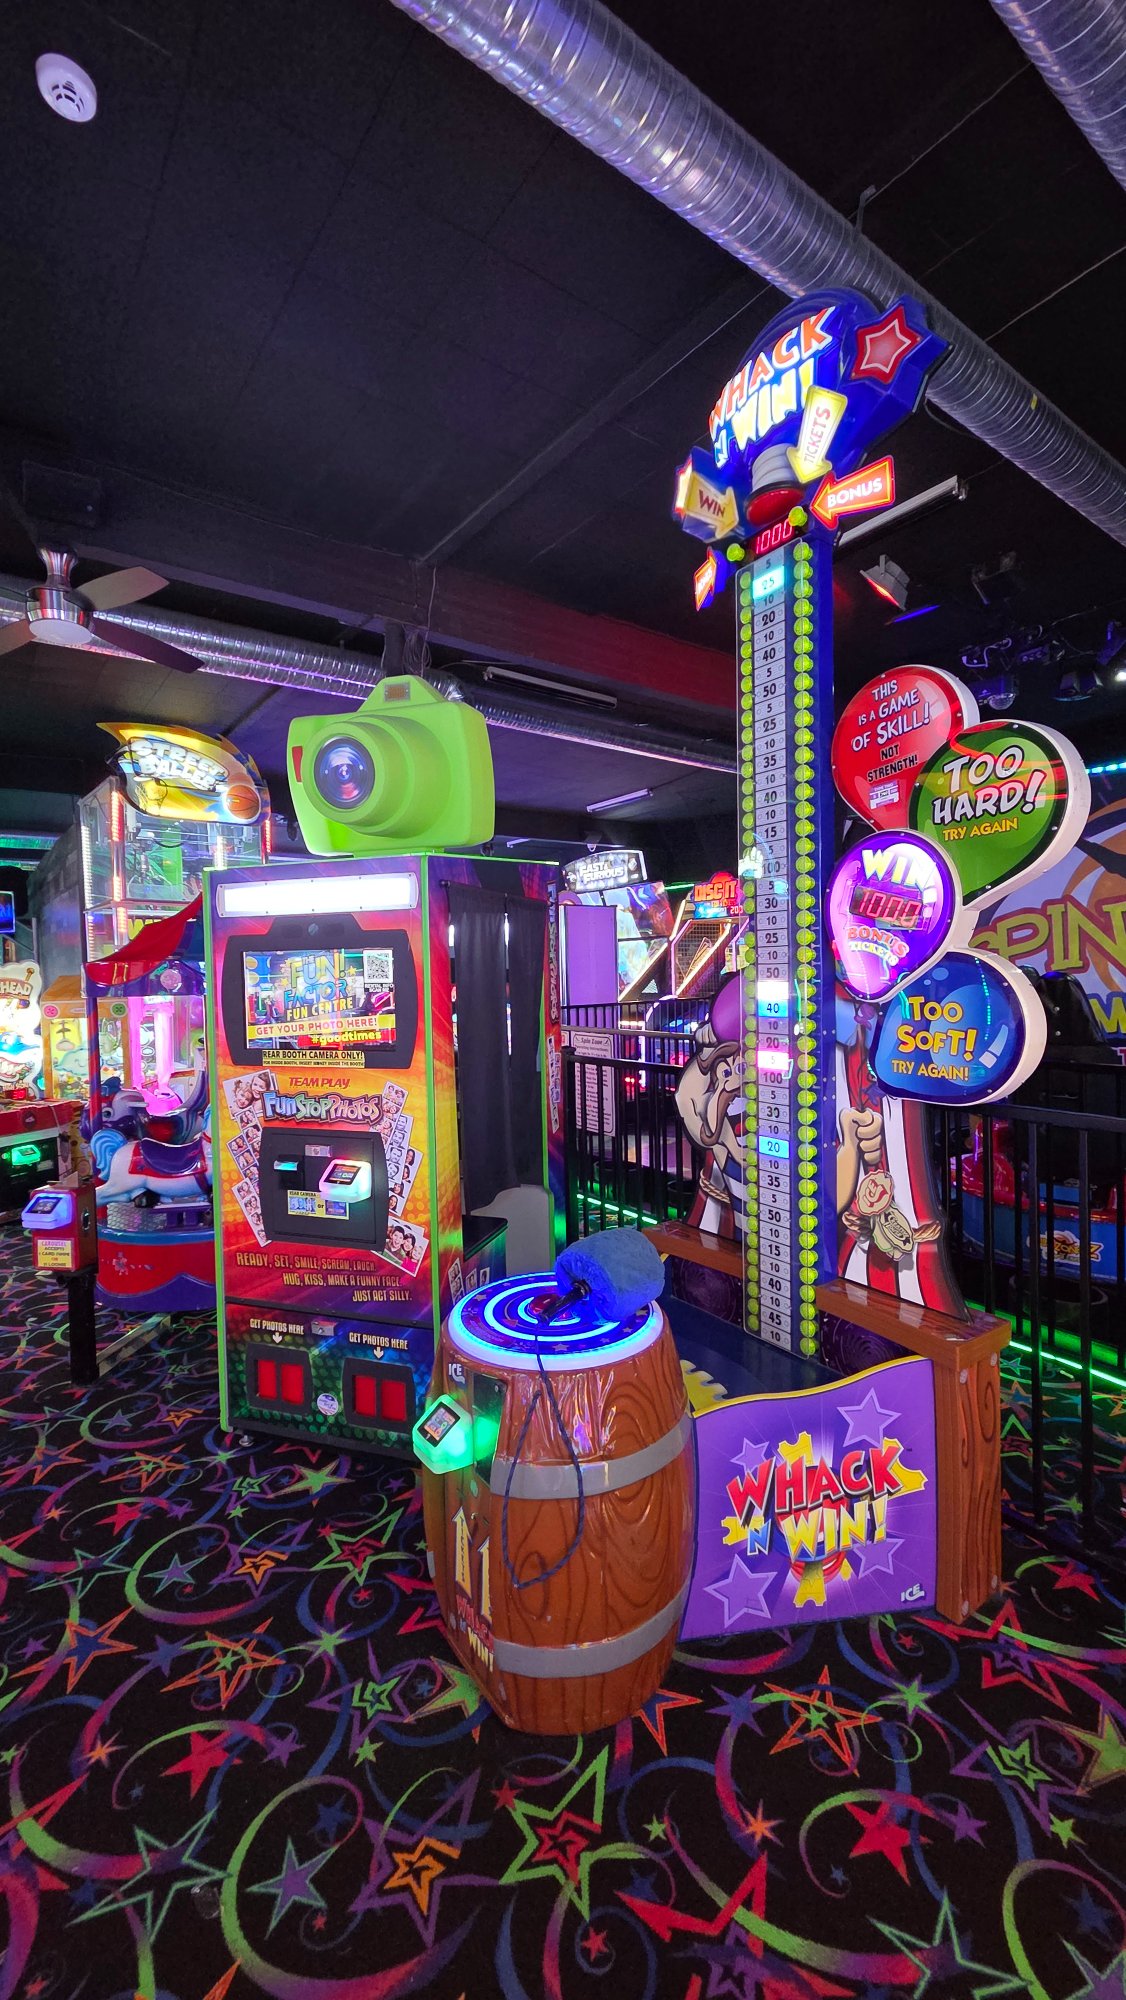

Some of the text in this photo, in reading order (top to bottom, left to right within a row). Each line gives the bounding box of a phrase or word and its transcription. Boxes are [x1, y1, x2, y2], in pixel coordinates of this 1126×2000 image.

[709, 306, 836, 441] WHACK
[732, 358, 814, 451] WIN!
[804, 406, 832, 464] TICKETS
[826, 478, 882, 508] BONUS
[698, 488, 725, 518] WIN
[755, 518, 793, 554] 1000
[762, 611, 775, 626] 20
[764, 631, 774, 642] 10
[763, 647, 776, 661] 40
[767, 668, 772, 677] 5
[763, 683, 777, 697] 50
[872, 680, 898, 701] THIS
[767, 704, 772, 713] 5
[858, 688, 920, 726] IS A GAME
[763, 719, 777, 732] 25
[851, 703, 930, 751] OF SKILL!
[765, 739, 775, 749] 10
[131, 740, 224, 776] STREET
[881, 744, 899, 761] NOT
[763, 755, 777, 768] 35
[867, 755, 918, 782] STRENGTH!
[943, 745, 1024, 793] TOO
[765, 774, 775, 785] 10
[764, 791, 777, 803] 40
[932, 769, 1047, 825] HARD!
[766, 810, 776, 820] 10
[765, 827, 777, 839] 15
[943, 817, 1018, 841] TRY AGAIN
[768, 846, 774, 855] 5
[579, 863, 603, 876] FAST
[763, 861, 780, 873] 100
[861, 848, 936, 888] WIN
[583, 867, 624, 883] FURIOUS
[695, 881, 737, 901] DISC IT
[765, 898, 778, 908] 30
[857, 888, 921, 928] 1000
[767, 916, 777, 925] 10
[765, 933, 779, 943] 25
[848, 925, 909, 959] BONUS
[767, 951, 778, 960] 10
[849, 941, 899, 966] TICKETS
[290, 950, 346, 988] FUN!
[766, 967, 780, 979] 50
[284, 980, 348, 1008] FACTOR
[286, 997, 353, 1021] FUN CENTRE
[767, 1003, 779, 1013] 40
[909, 996, 963, 1022] TOO
[256, 1017, 377, 1035] GET YOUR PHOTO HERE!
[768, 1022, 778, 1030] 10
[311, 1030, 381, 1046] #goodtimes
[766, 1037, 779, 1048] 20
[897, 1024, 978, 1062] SOFT!
[309, 1051, 338, 1059] CAMERA
[892, 1059, 969, 1081] TRY AGAIN!
[289, 1077, 350, 1089] TEAM PLAY
[763, 1072, 783, 1084] 100
[771, 1091, 776, 1100] 5
[767, 1107, 779, 1118] 30
[768, 1126, 779, 1135] 10
[767, 1141, 780, 1153] 20
[769, 1161, 779, 1169] 10
[767, 1175, 780, 1188] 35
[772, 1194, 777, 1203] 5
[768, 1210, 781, 1222] 50
[769, 1228, 780, 1238] 10
[768, 1246, 780, 1256] 15
[236, 1252, 376, 1271] READY, SET, SMILE, SCREAM, LAUGH.
[770, 1262, 780, 1272] 10
[283, 1273, 303, 1287] HUG,
[304, 1274, 326, 1287] KISS,
[328, 1274, 349, 1286] MAKE
[350, 1275, 356, 1286] A
[357, 1275, 381, 1287] FUNNY
[768, 1278, 782, 1291] 40
[352, 1290, 412, 1302] JUST ACT SILLY.
[770, 1297, 780, 1307] 10
[769, 1312, 782, 1325] 45
[250, 1319, 304, 1335] GET PHOTOS HERE
[349, 1332, 408, 1350] GET PHOTOS HERE
[770, 1331, 780, 1341] 10
[449, 1364, 465, 1383] ICE
[726, 1445, 904, 1527] WHACK
[747, 1494, 888, 1562] N WIN!
[900, 1583, 925, 1602] ICE
